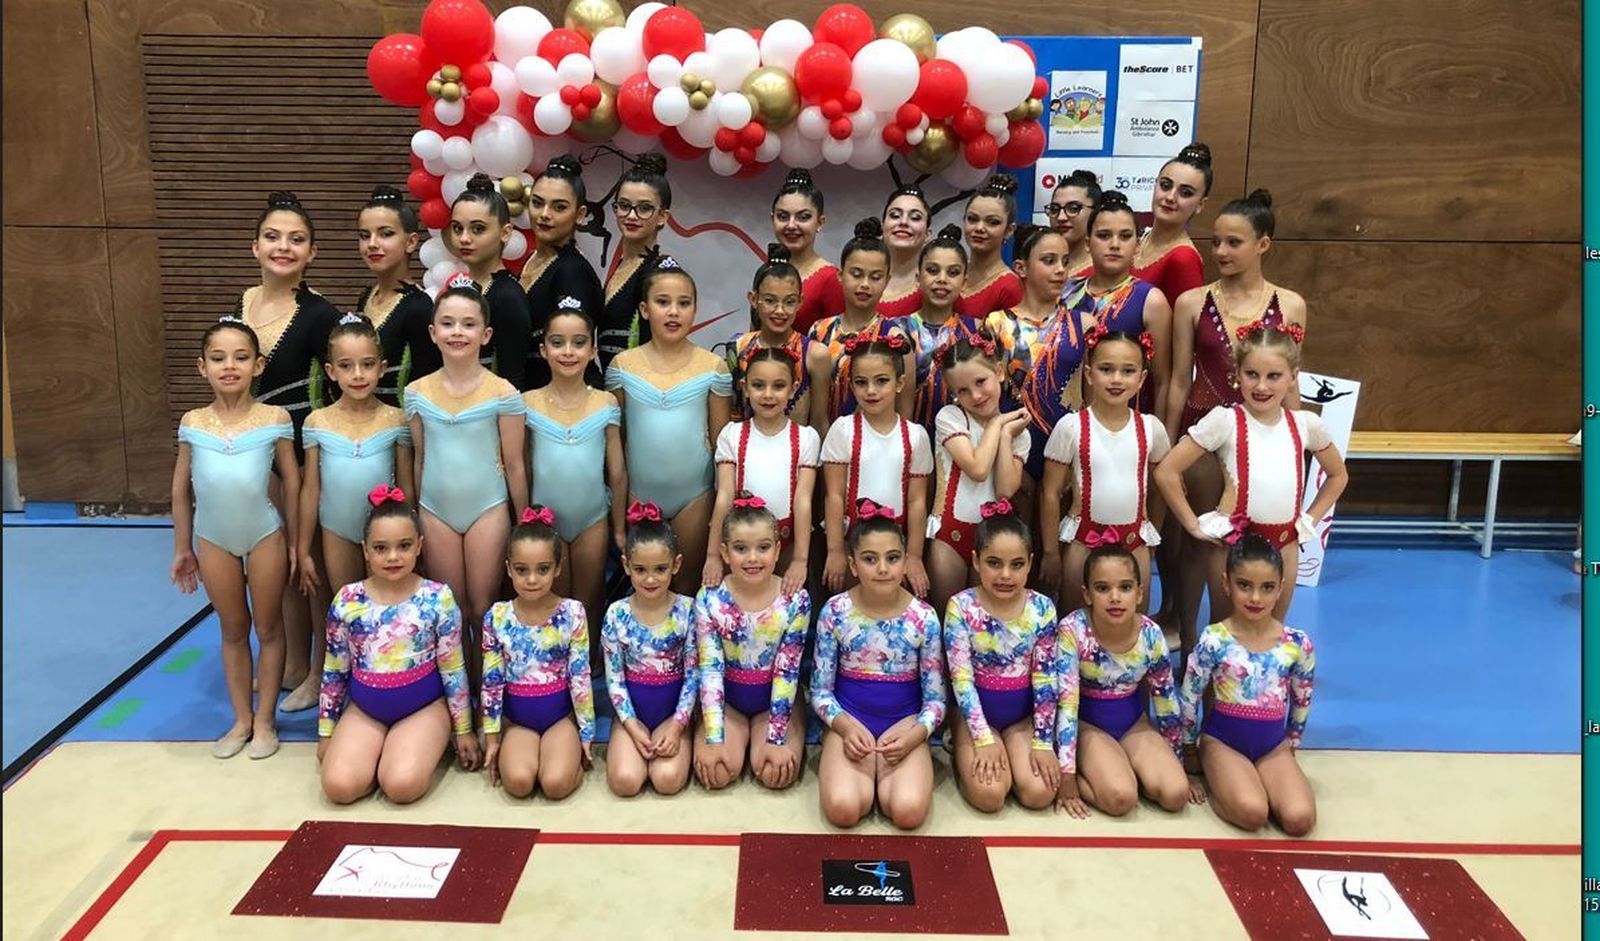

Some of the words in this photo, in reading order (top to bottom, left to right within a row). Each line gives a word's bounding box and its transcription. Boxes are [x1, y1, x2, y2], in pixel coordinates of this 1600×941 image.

[1123, 64, 1169, 73] theScore
[1176, 65, 1194, 73] BET
[1054, 86, 1071, 98] Little
[1072, 84, 1103, 97] Learners
[1130, 117, 1139, 125] St
[1140, 117, 1160, 126] John
[828, 884, 854, 896] La
[857, 884, 903, 896] Belle
